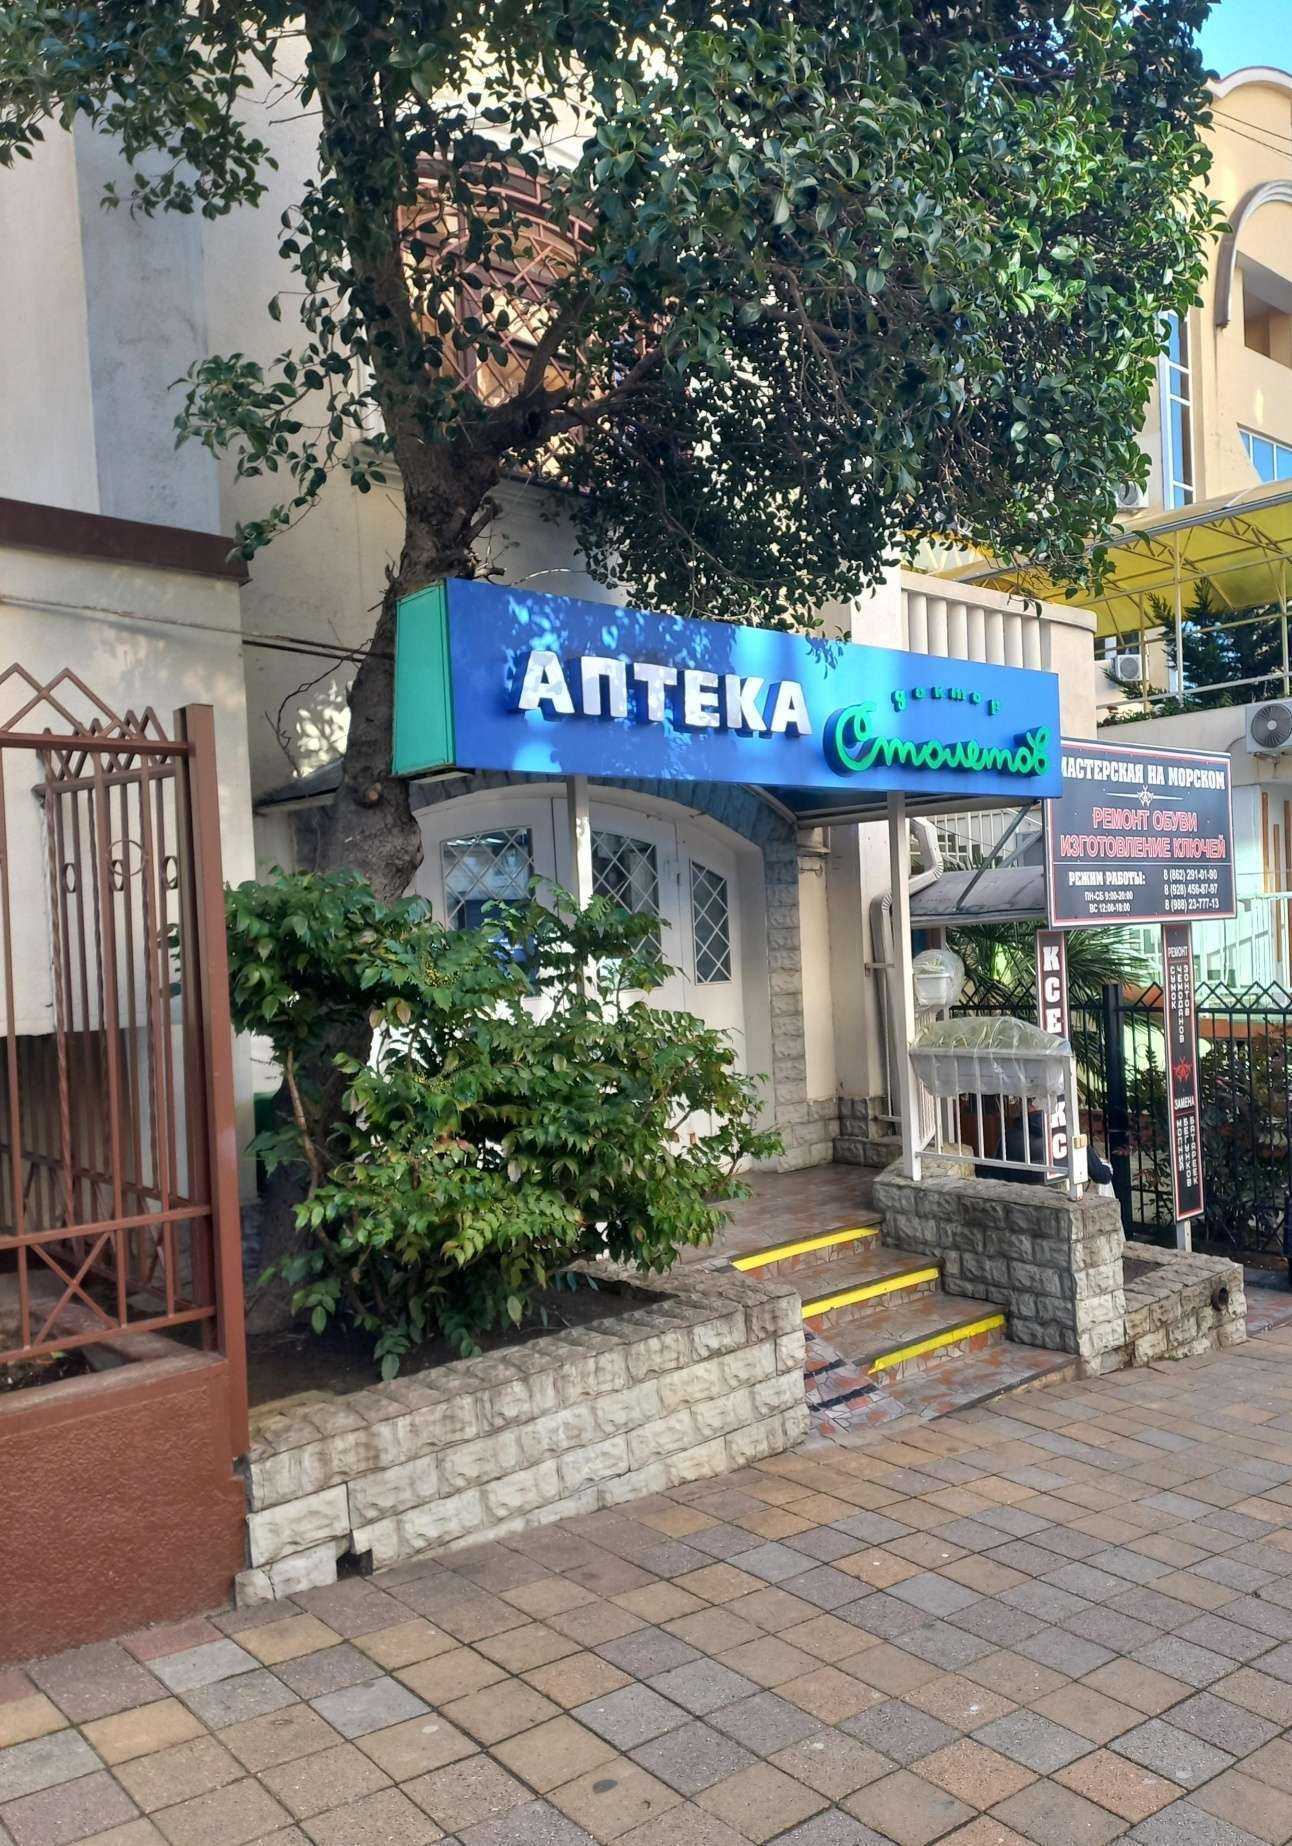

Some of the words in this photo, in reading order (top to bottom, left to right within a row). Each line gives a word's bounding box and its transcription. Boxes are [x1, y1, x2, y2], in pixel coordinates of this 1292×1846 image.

[517, 650, 812, 735] АПТЕКА
[828, 700, 1050, 777] Столетов
[1148, 766, 1166, 786] НА
[1168, 766, 1225, 790] МОРСКОМ
[1092, 807, 1150, 831] РЕМОНТ
[1152, 810, 1198, 832] ОБУВИ
[1060, 834, 1171, 858] ИЗГОТОВЛЕНИЕ
[1173, 834, 1226, 859] КЛЮЧЕЙ
[1068, 871, 1104, 886] РЕЖИМ
[1106, 871, 1146, 886] РАБОТЫ:
[1163, 869, 1169, 880] 8
[1084, 891, 1104, 901] ПН-СБ
[1164, 884, 1169, 895] 8
[1089, 903, 1098, 913] ВС
[1165, 899, 1170, 910] 8
[1167, 945, 1188, 958] РЕМОНТ
[1176, 965, 1185, 1044] ЧЕМОДАНОВ
[1174, 1096, 1195, 1110] ЗАМЕНА
[1189, 1115, 1199, 1185] БАТАРЕЕК
